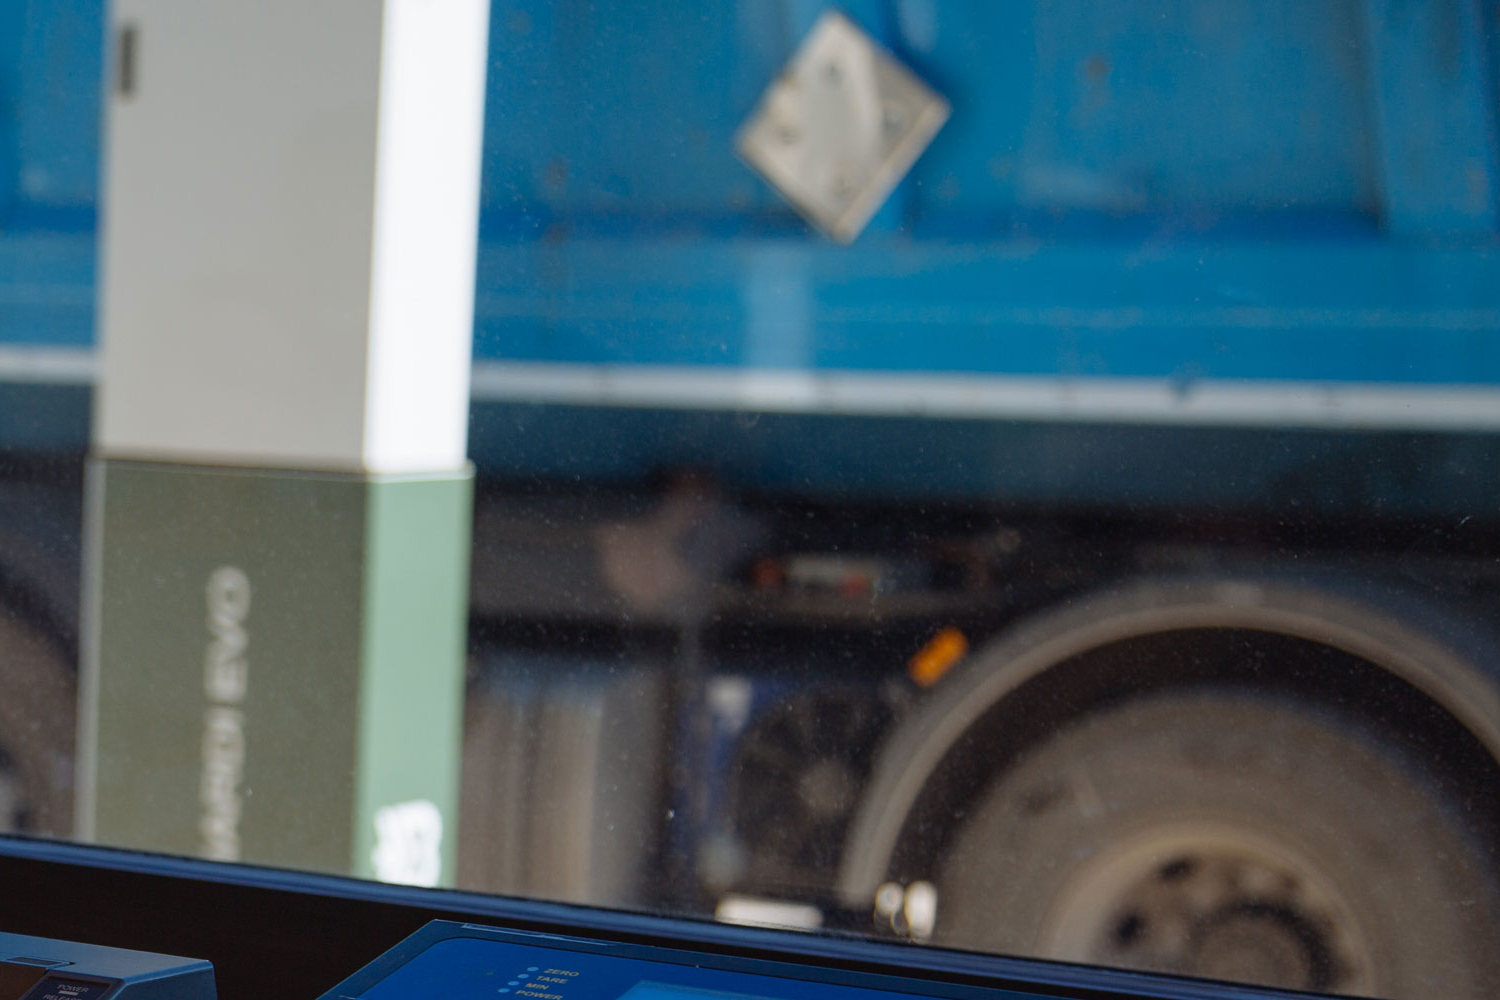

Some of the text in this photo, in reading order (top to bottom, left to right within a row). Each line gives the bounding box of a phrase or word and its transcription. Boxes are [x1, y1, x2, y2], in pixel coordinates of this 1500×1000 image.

[543, 968, 580, 978] ZERO
[536, 975, 569, 985] TARE
[57, 984, 89, 993] POWER
[524, 982, 550, 991] MIN
[515, 989, 564, 1000] POWER
